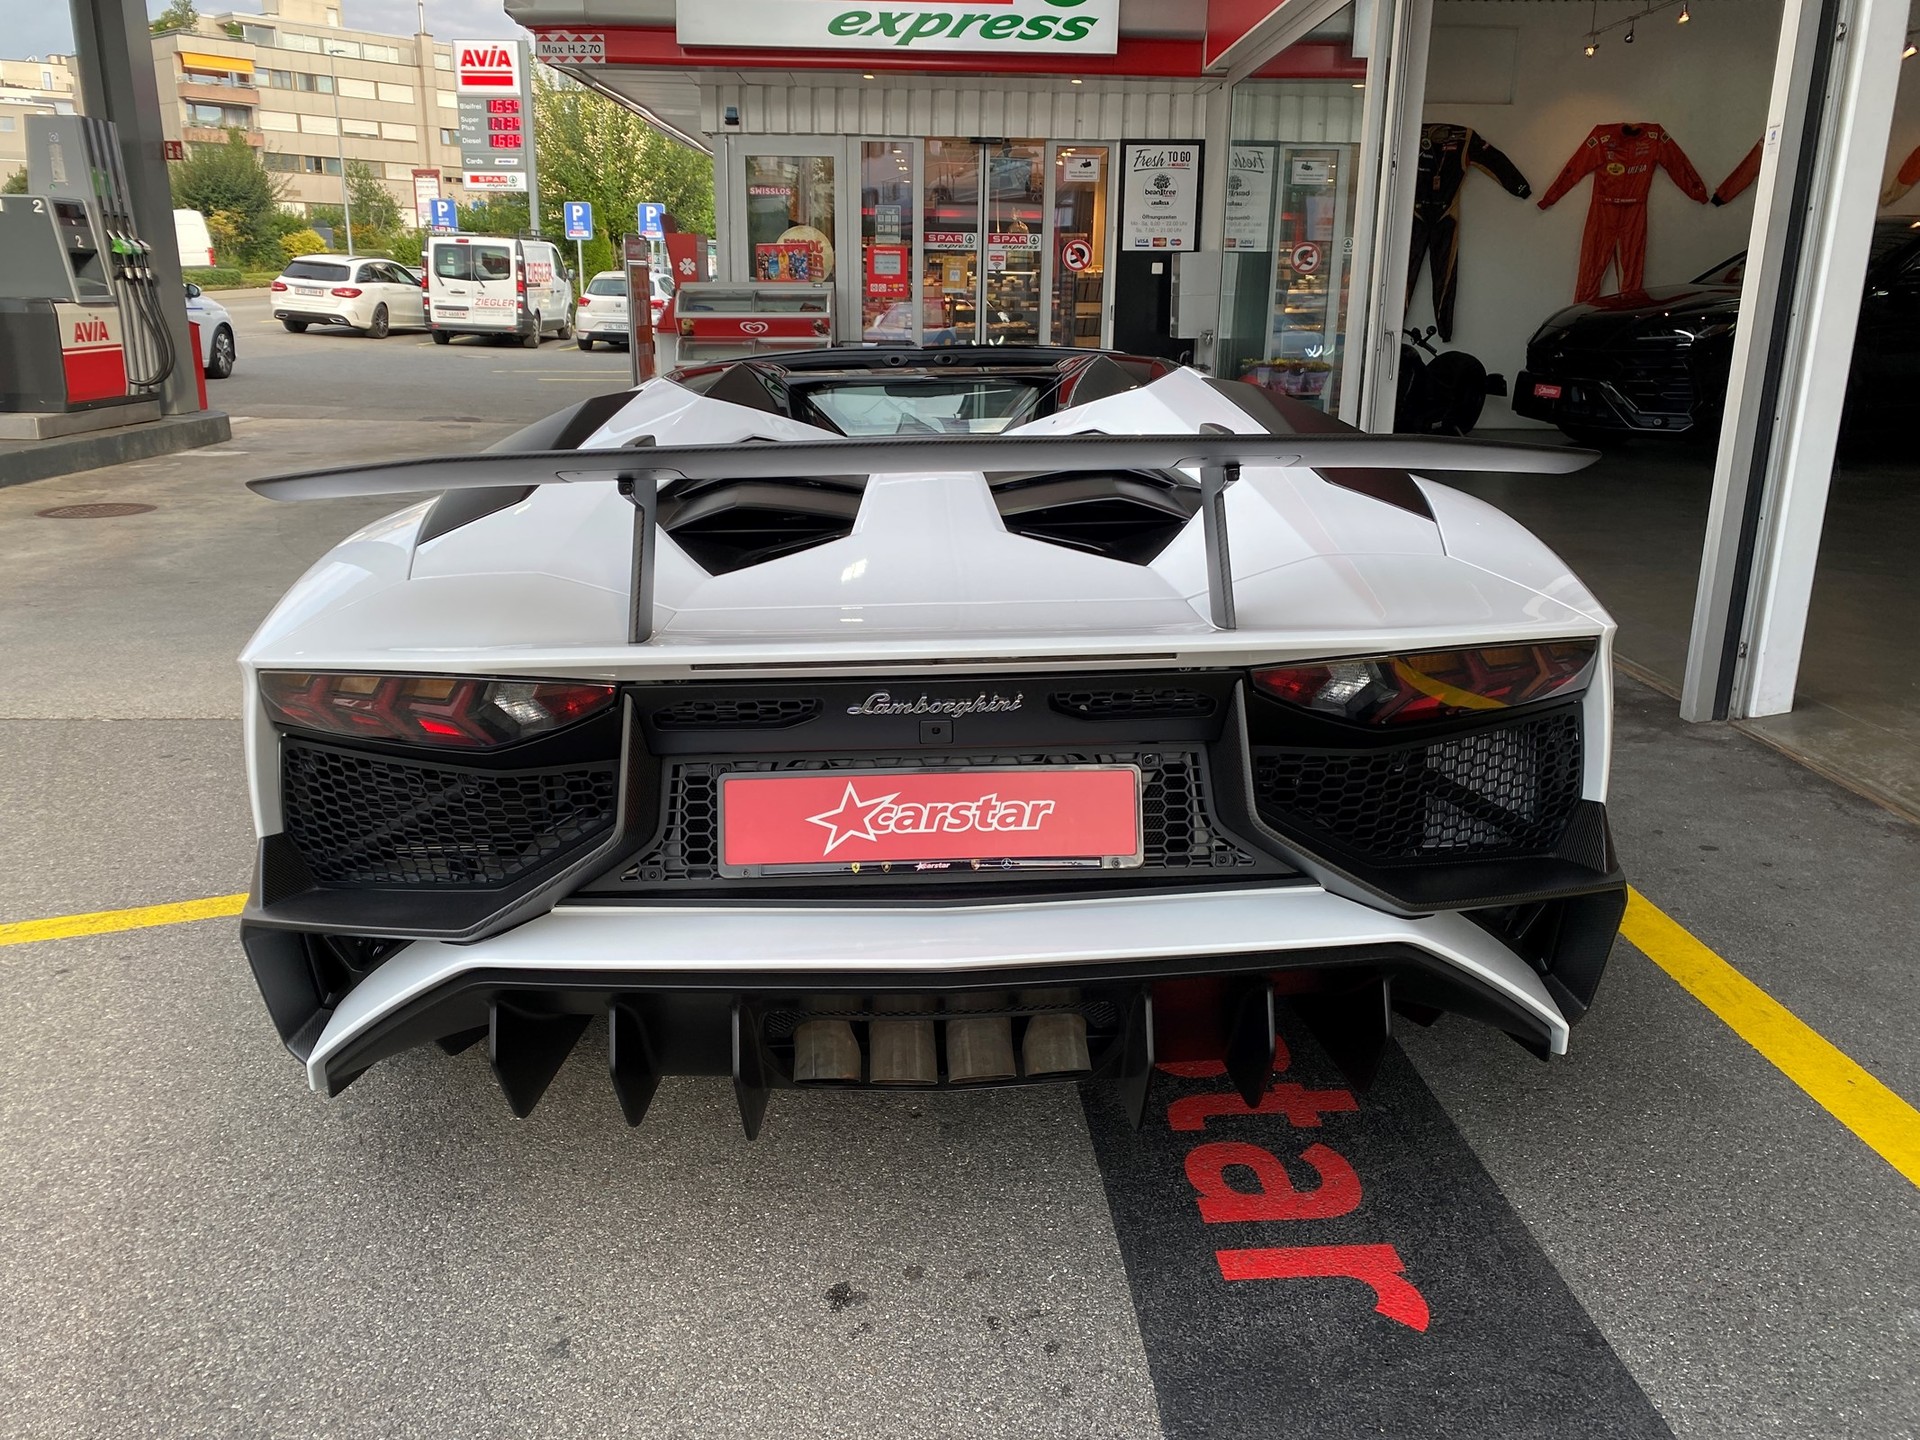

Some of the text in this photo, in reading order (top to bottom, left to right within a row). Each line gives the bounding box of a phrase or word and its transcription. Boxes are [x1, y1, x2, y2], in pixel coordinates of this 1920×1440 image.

[827, 10, 1099, 46] express
[460, 46, 512, 67] AVIA
[542, 44, 564, 54] Max
[580, 44, 602, 54] 2.70
[460, 116, 480, 124] Super
[1133, 148, 1191, 168] Fresh TO GO
[749, 187, 791, 196] SWISSLOS
[32, 199, 45, 213] 2
[437, 201, 449, 217] P
[572, 205, 584, 221] P
[645, 206, 657, 222] P
[75, 235, 84, 248] 2
[927, 233, 964, 243] SPAR
[992, 234, 1028, 243] SPAR
[474, 298, 515, 307] ZIEGLER
[74, 317, 109, 342] AVIA
[846, 691, 1025, 718] Lamborghini
[868, 792, 1056, 835] carstar
[922, 862, 951, 870] carstar
